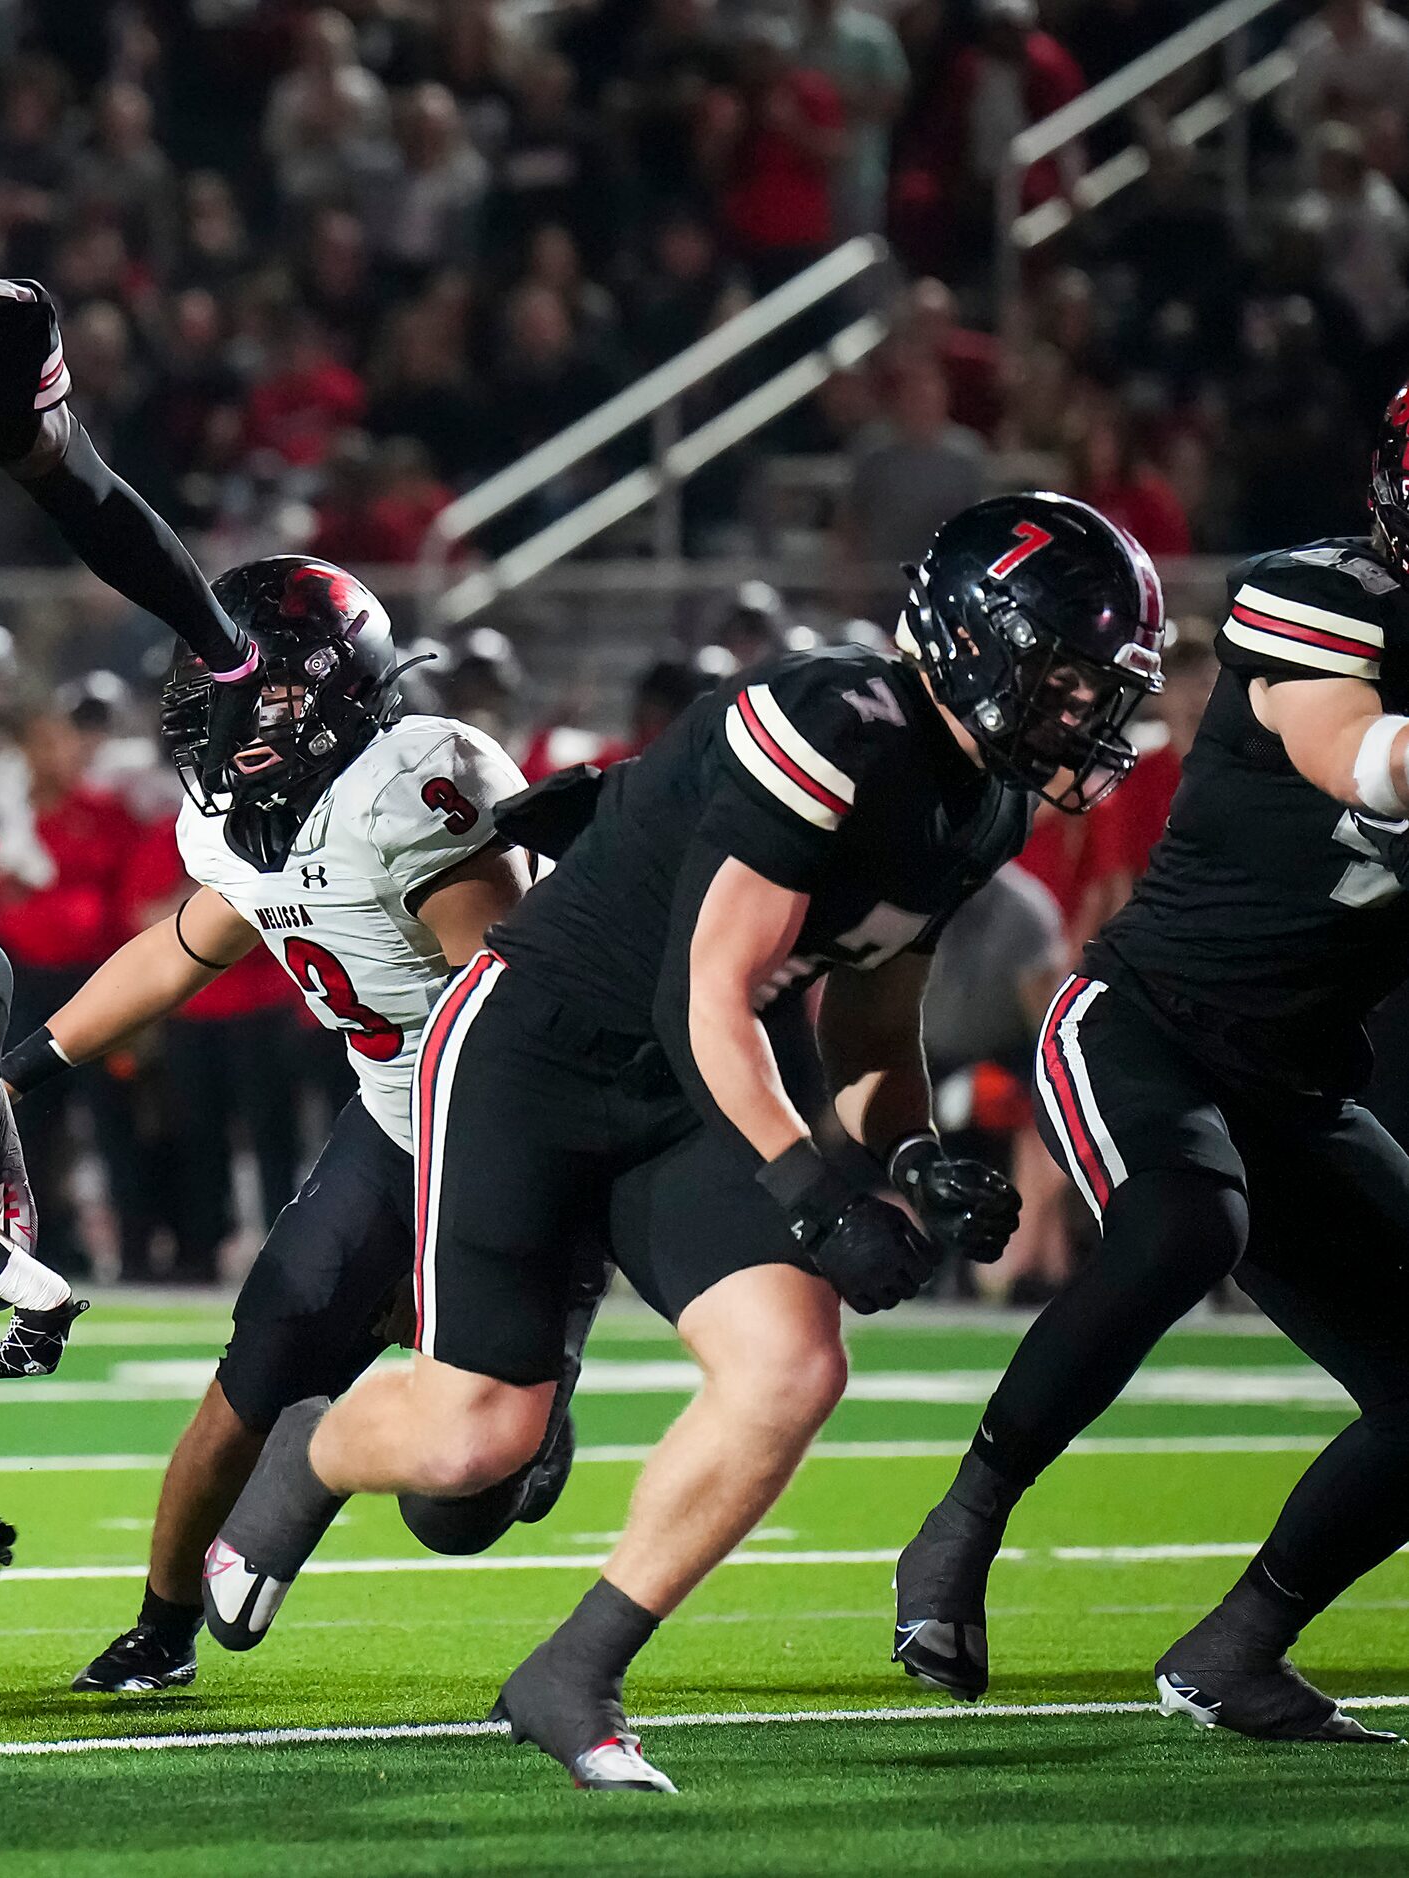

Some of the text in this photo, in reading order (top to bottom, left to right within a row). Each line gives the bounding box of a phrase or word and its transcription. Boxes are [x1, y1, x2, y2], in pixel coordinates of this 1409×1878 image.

[987, 521, 1054, 580] 7
[421, 776, 479, 836] 3
[254, 903, 314, 930] MELISSA
[282, 935, 405, 1063] 3
